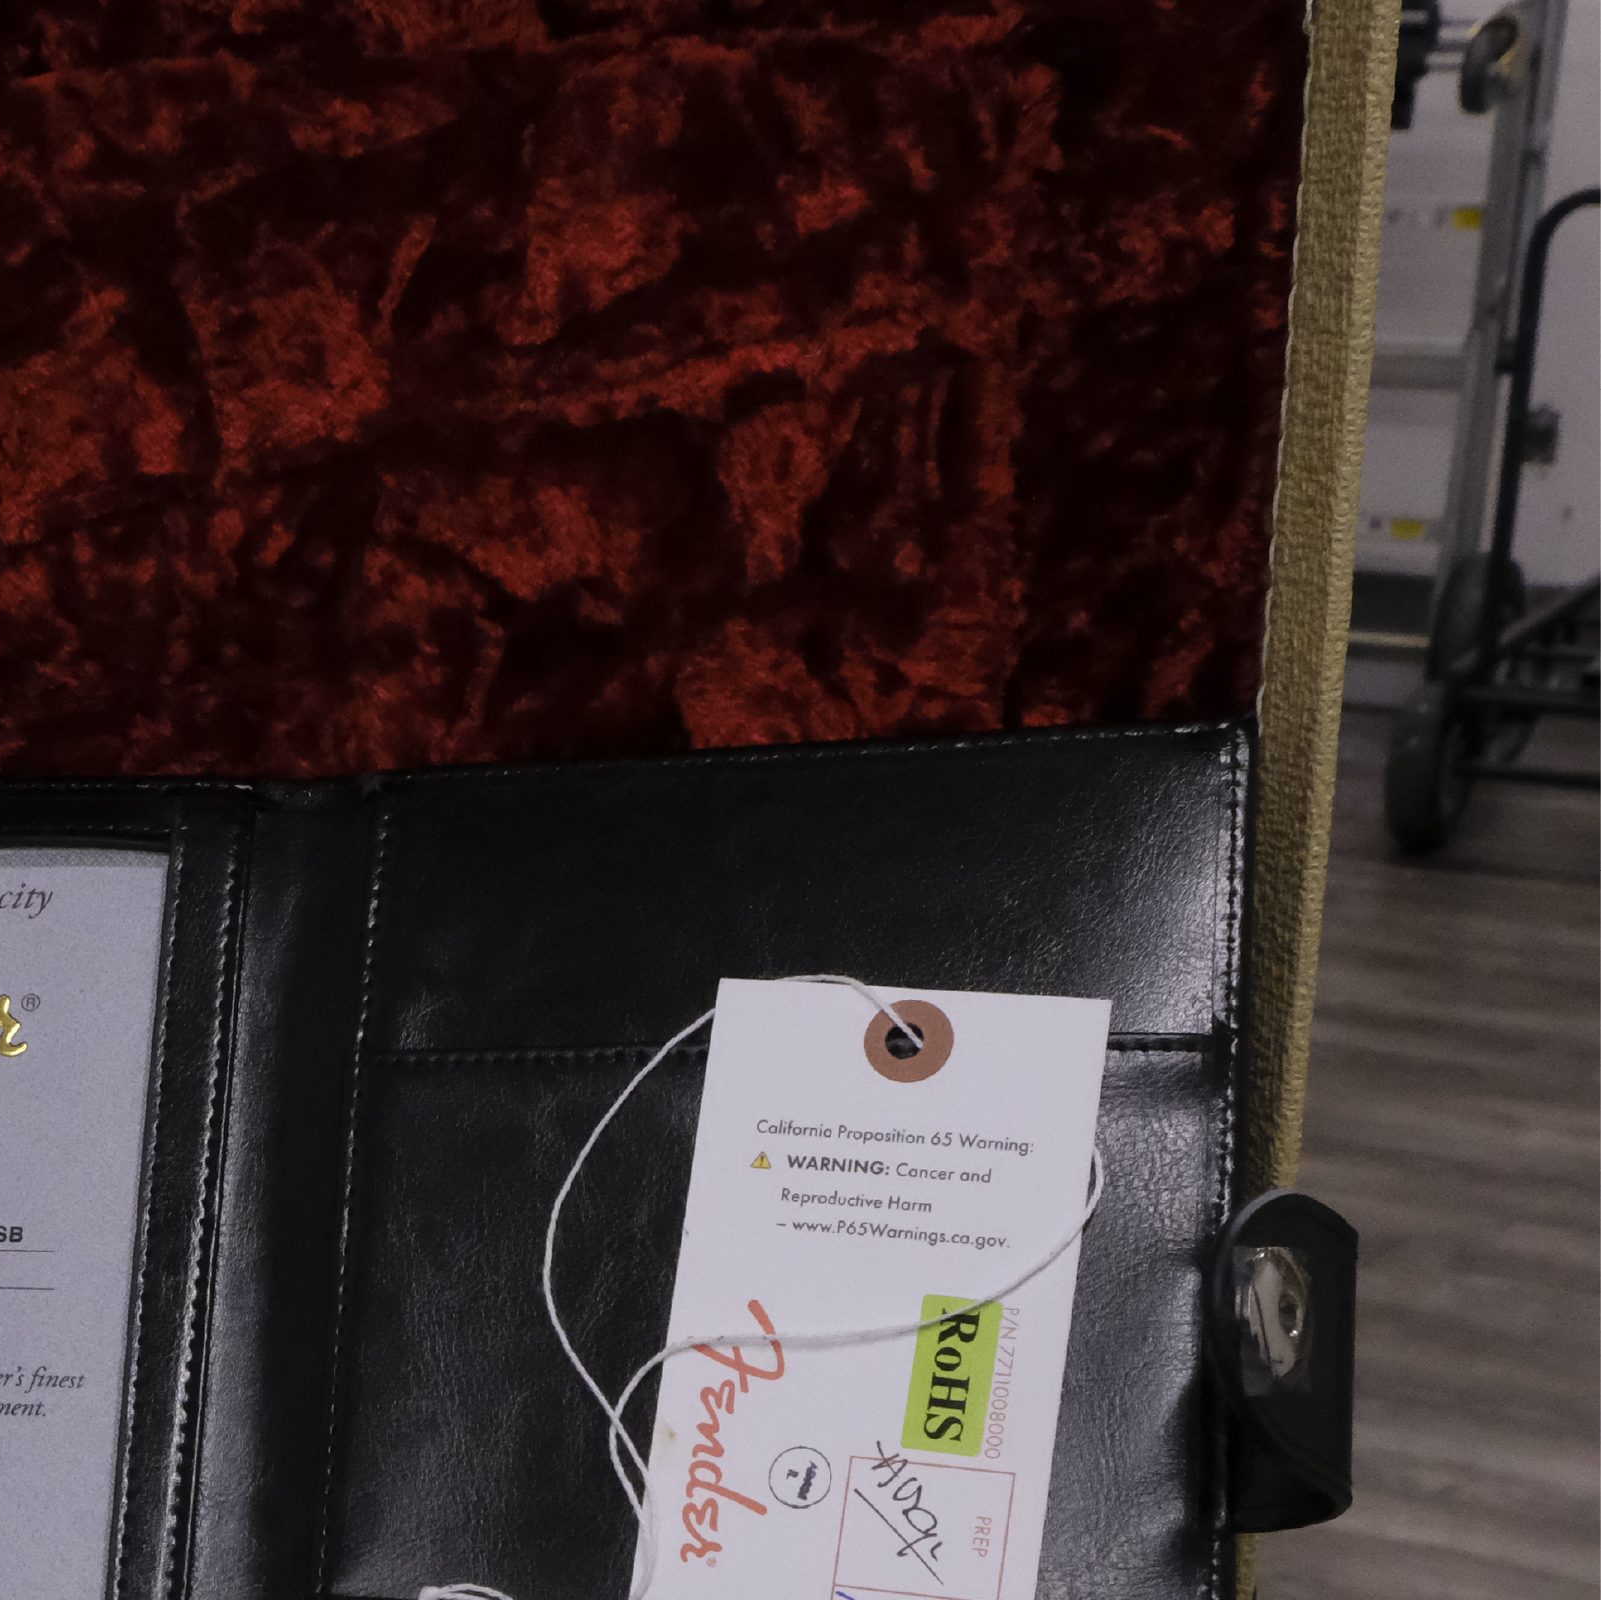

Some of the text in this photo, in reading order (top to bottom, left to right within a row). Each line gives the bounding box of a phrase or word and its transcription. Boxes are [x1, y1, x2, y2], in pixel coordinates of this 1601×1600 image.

[756, 1119, 1034, 1157] California Proposition 65 Warning:
[787, 1155, 992, 1183] WARNING: Cancer and
[780, 1187, 932, 1213] Reproductive Harm
[792, 1219, 1010, 1250] www.P65Warnings.ca.gov.
[23, 1365, 86, 1393] finest
[922, 1308, 981, 1442] RoHS
[985, 1306, 1020, 1459] P/N 7711008000
[972, 1515, 993, 1558] PREP
